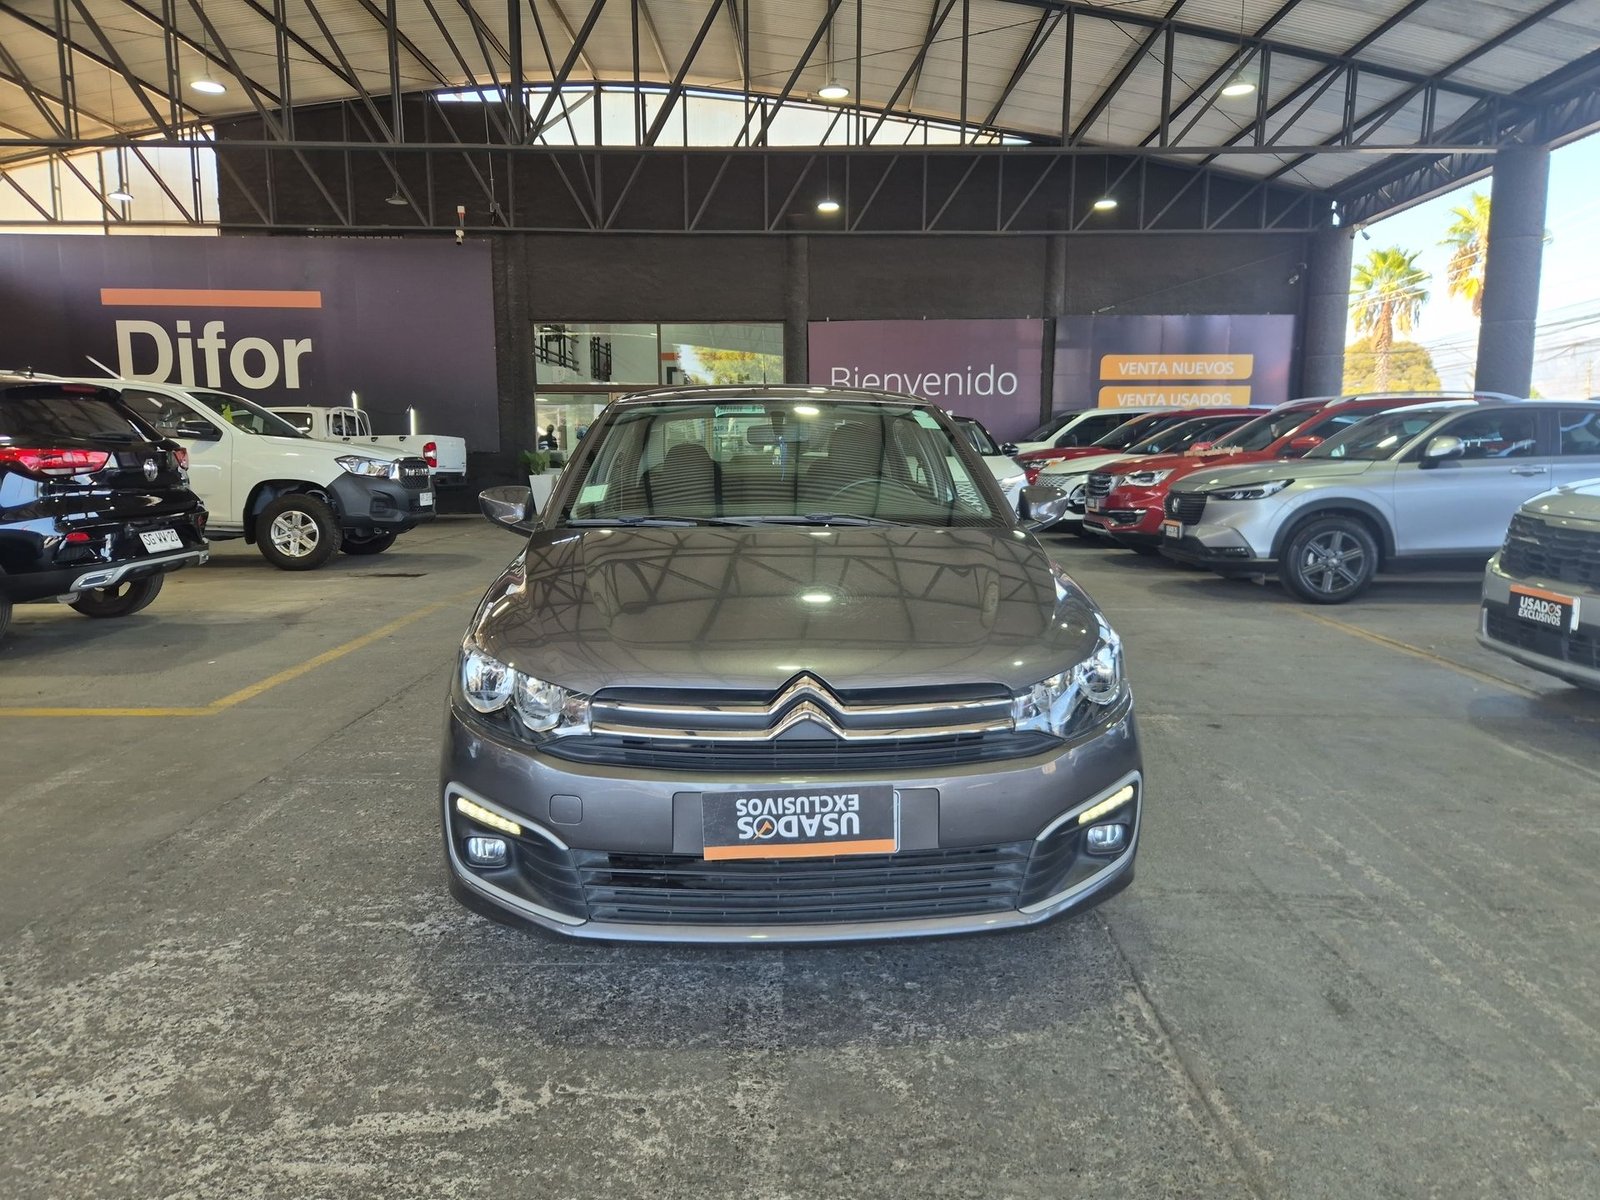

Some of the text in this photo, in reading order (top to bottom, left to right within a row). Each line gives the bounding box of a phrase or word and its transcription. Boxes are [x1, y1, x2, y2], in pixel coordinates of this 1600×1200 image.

[115, 320, 312, 389] Difor
[1119, 361, 1234, 375] VENTA NUEVOS
[831, 364, 1018, 396] Bienvenido
[1117, 393, 1232, 406] VENTA USADOS
[1518, 607, 1560, 627] EXCLUSIVOS
[1520, 596, 1561, 617] USADOS
[736, 794, 860, 816] EXCLUSIVOS
[737, 811, 860, 840] USADOS
